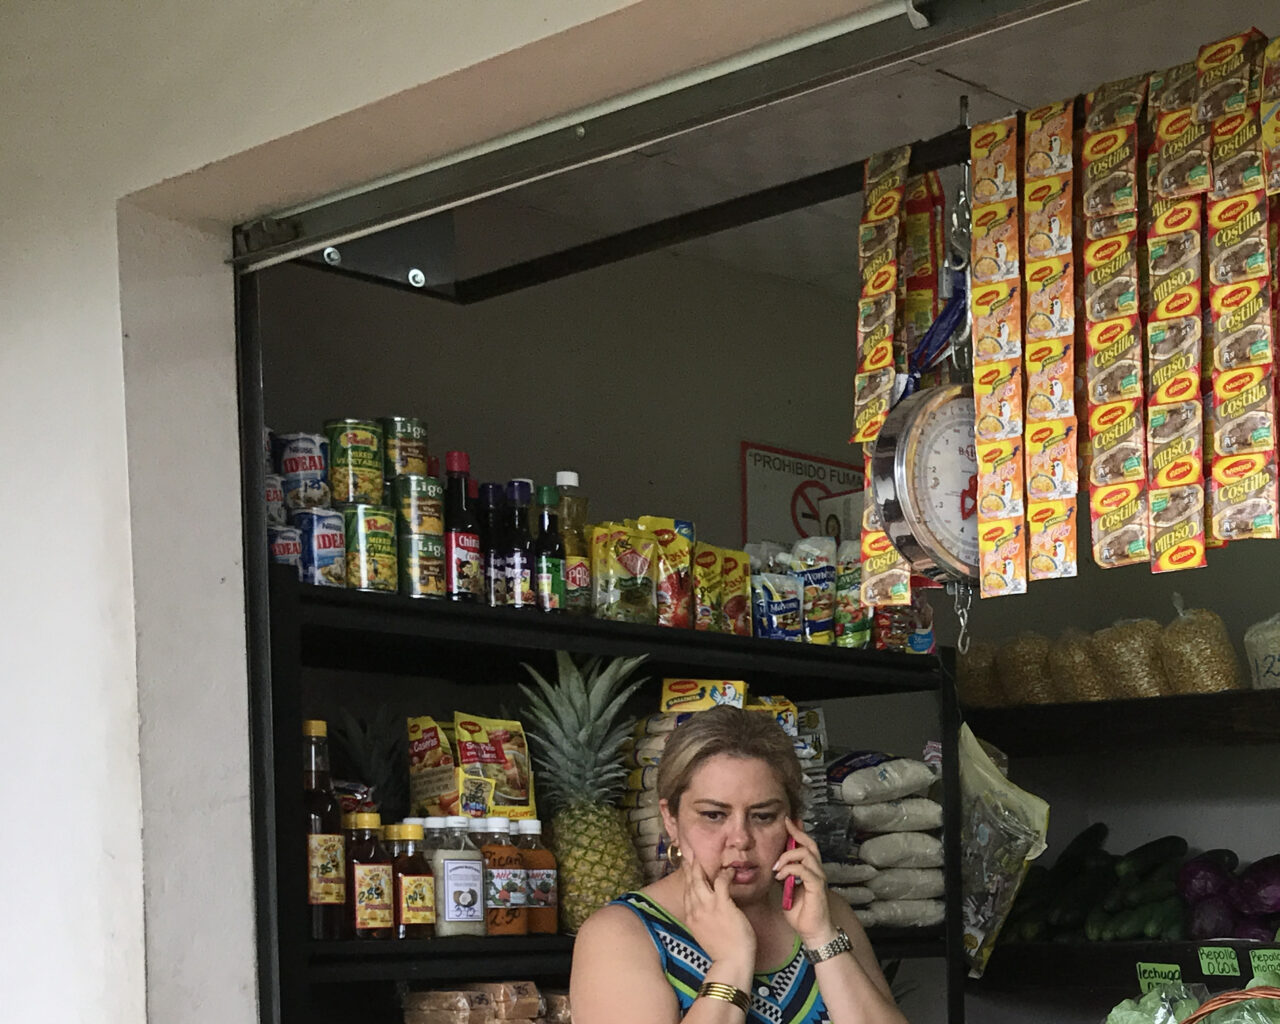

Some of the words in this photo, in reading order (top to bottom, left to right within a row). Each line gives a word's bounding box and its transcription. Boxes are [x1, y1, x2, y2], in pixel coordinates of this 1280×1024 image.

[1215, 210, 1262, 248] Costilla
[1217, 296, 1264, 332] Costilla
[1220, 385, 1267, 419] Costilla
[410, 480, 443, 497] Ligo
[1218, 472, 1270, 502] Costilla
[1200, 948, 1236, 965] Repollo
